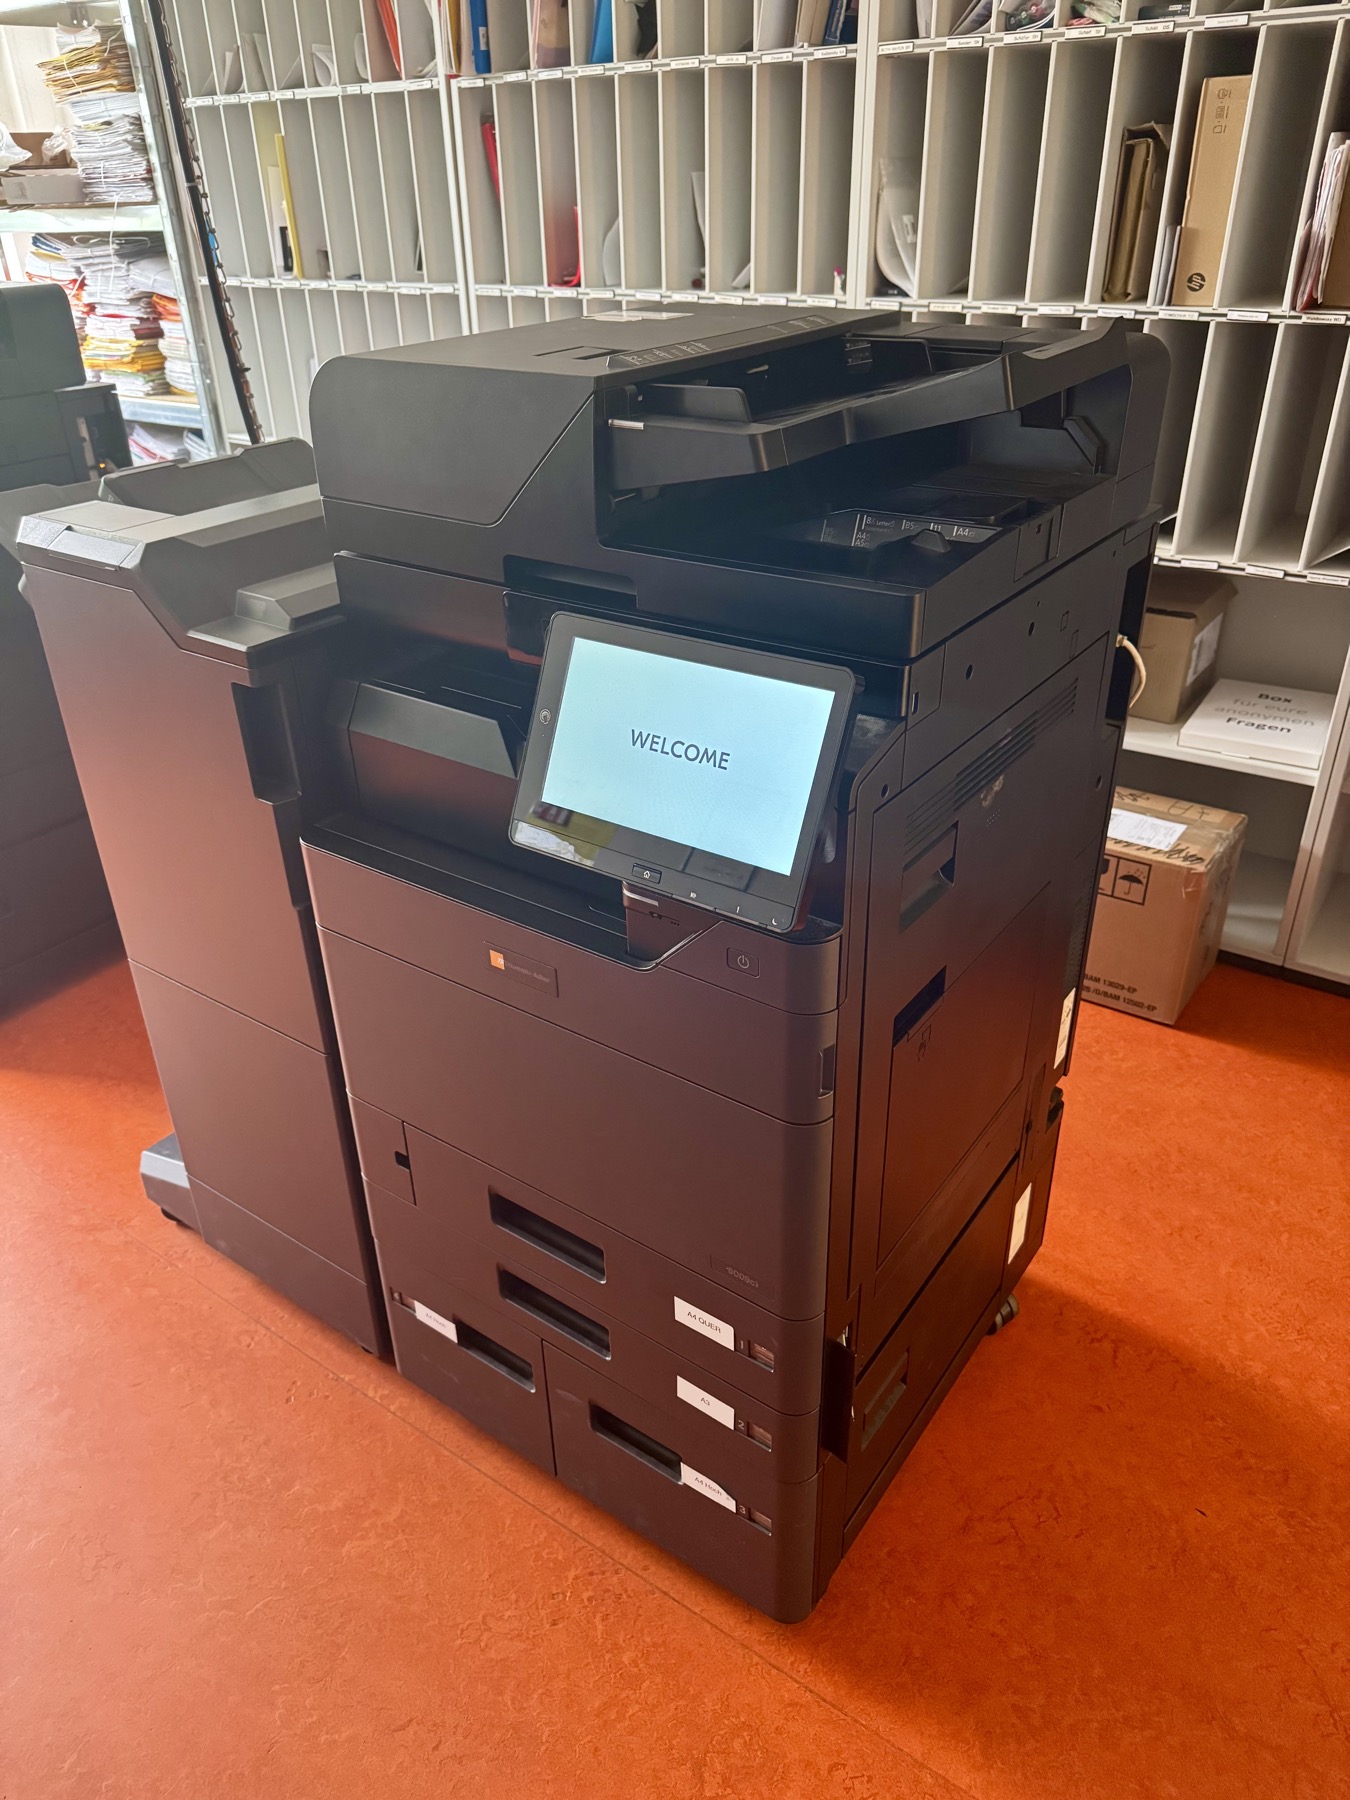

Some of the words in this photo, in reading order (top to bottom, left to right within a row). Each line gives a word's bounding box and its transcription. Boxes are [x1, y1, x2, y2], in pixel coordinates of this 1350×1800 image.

[1187, 272, 1206, 292] hp
[856, 531, 867, 539] A4
[957, 527, 969, 537] A4
[855, 539, 865, 547] A5
[1258, 692, 1293, 704] Box
[1233, 697, 1259, 708] für
[1264, 703, 1309, 716] eure
[1214, 706, 1315, 727] anonymen
[1226, 716, 1292, 733] Fragen
[631, 728, 731, 771] WELCOME
[687, 1310, 698, 1321] A4
[698, 1316, 722, 1334] QUER
[700, 1396, 711, 1407] A3
[738, 1419, 745, 1430] 2
[739, 1505, 746, 1514] 3
